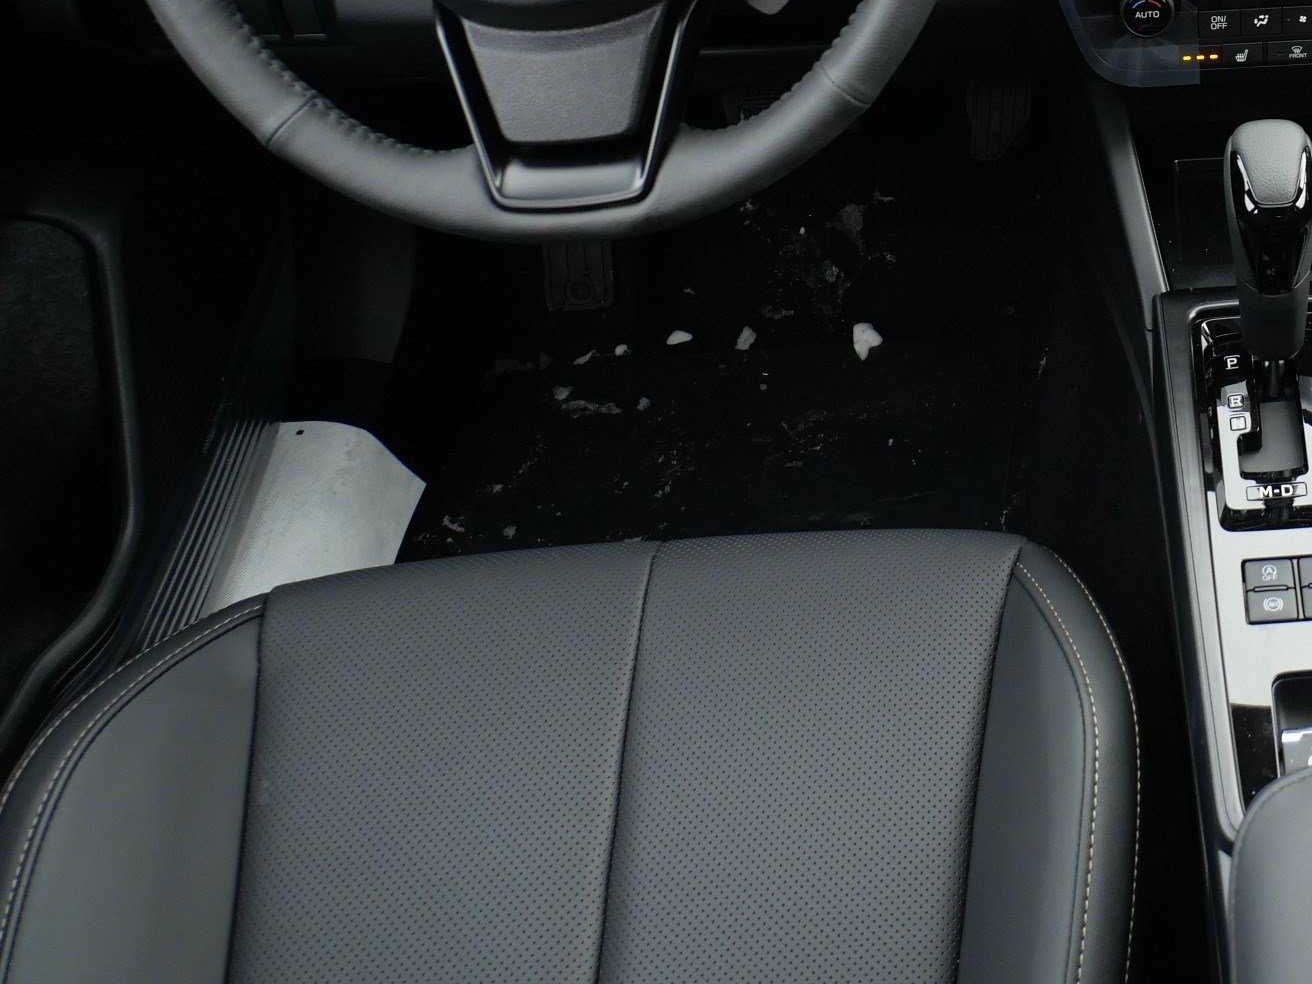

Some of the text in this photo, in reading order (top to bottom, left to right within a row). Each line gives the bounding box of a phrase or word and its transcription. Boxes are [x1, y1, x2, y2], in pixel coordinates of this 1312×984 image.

[1135, 10, 1160, 19] AUTO
[1211, 15, 1227, 23] ON/
[1210, 22, 1228, 30] OFF
[1227, 358, 1238, 368] P
[1230, 397, 1243, 407] R
[1260, 484, 1294, 498] M-D
